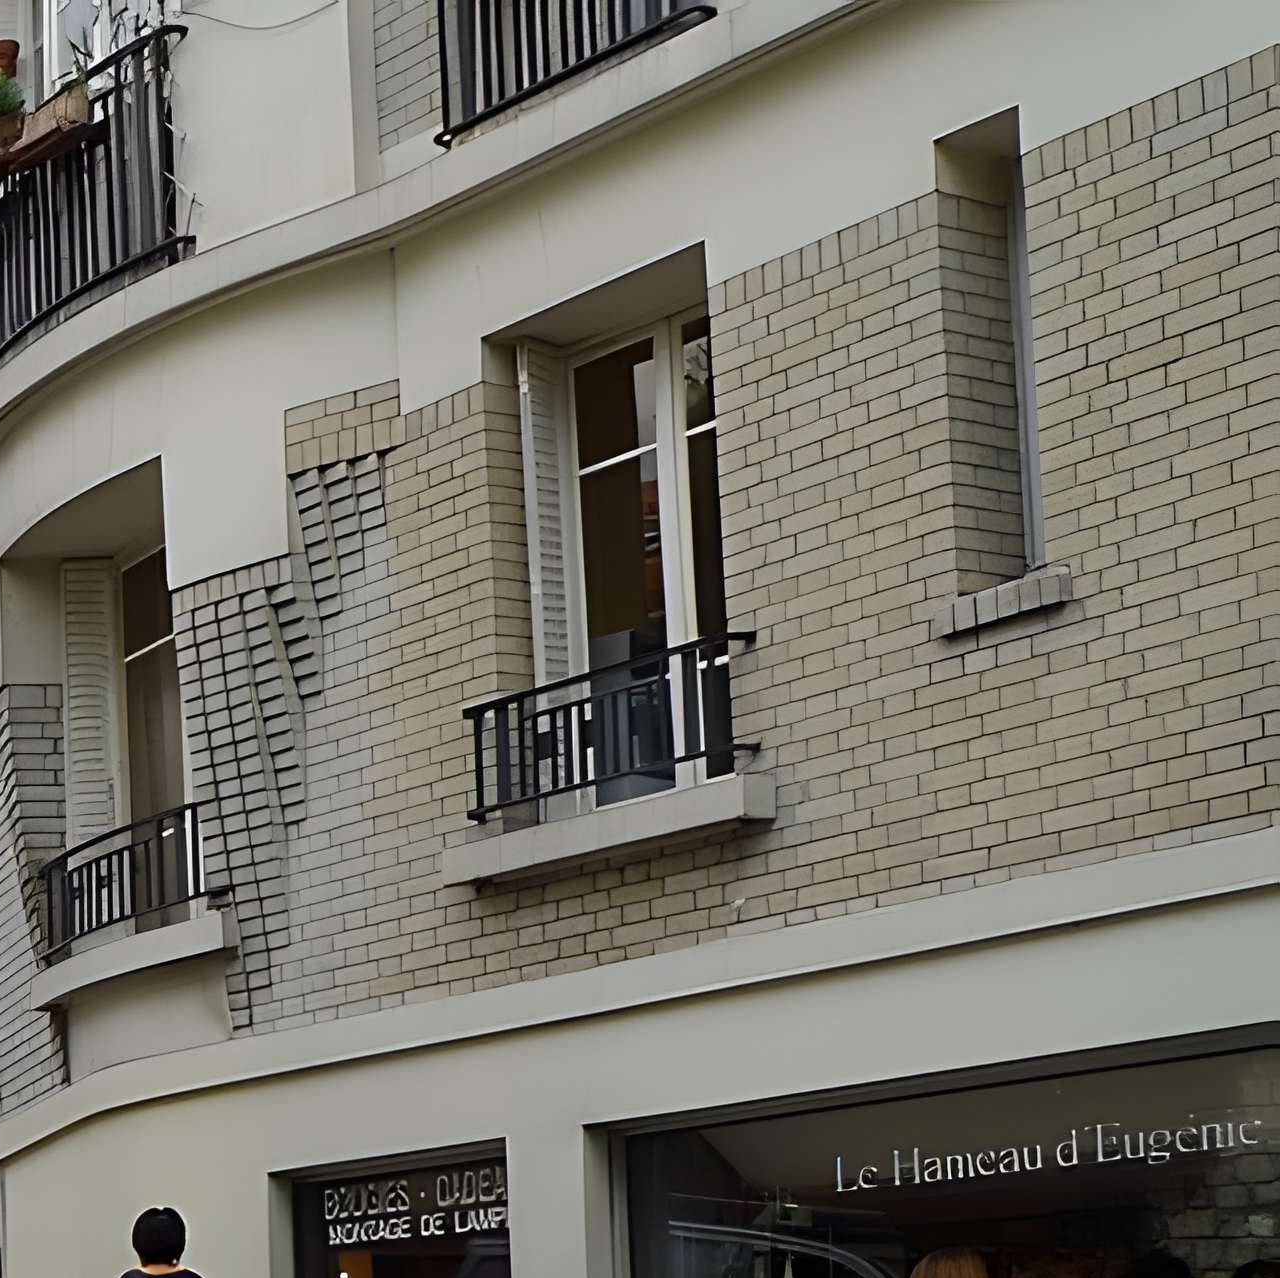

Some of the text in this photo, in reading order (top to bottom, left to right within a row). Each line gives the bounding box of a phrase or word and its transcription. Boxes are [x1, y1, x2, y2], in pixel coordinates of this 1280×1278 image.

[836, 1156, 878, 1192] Le
[893, 1144, 1043, 1186] Hameau
[420, 1212, 446, 1237] DE
